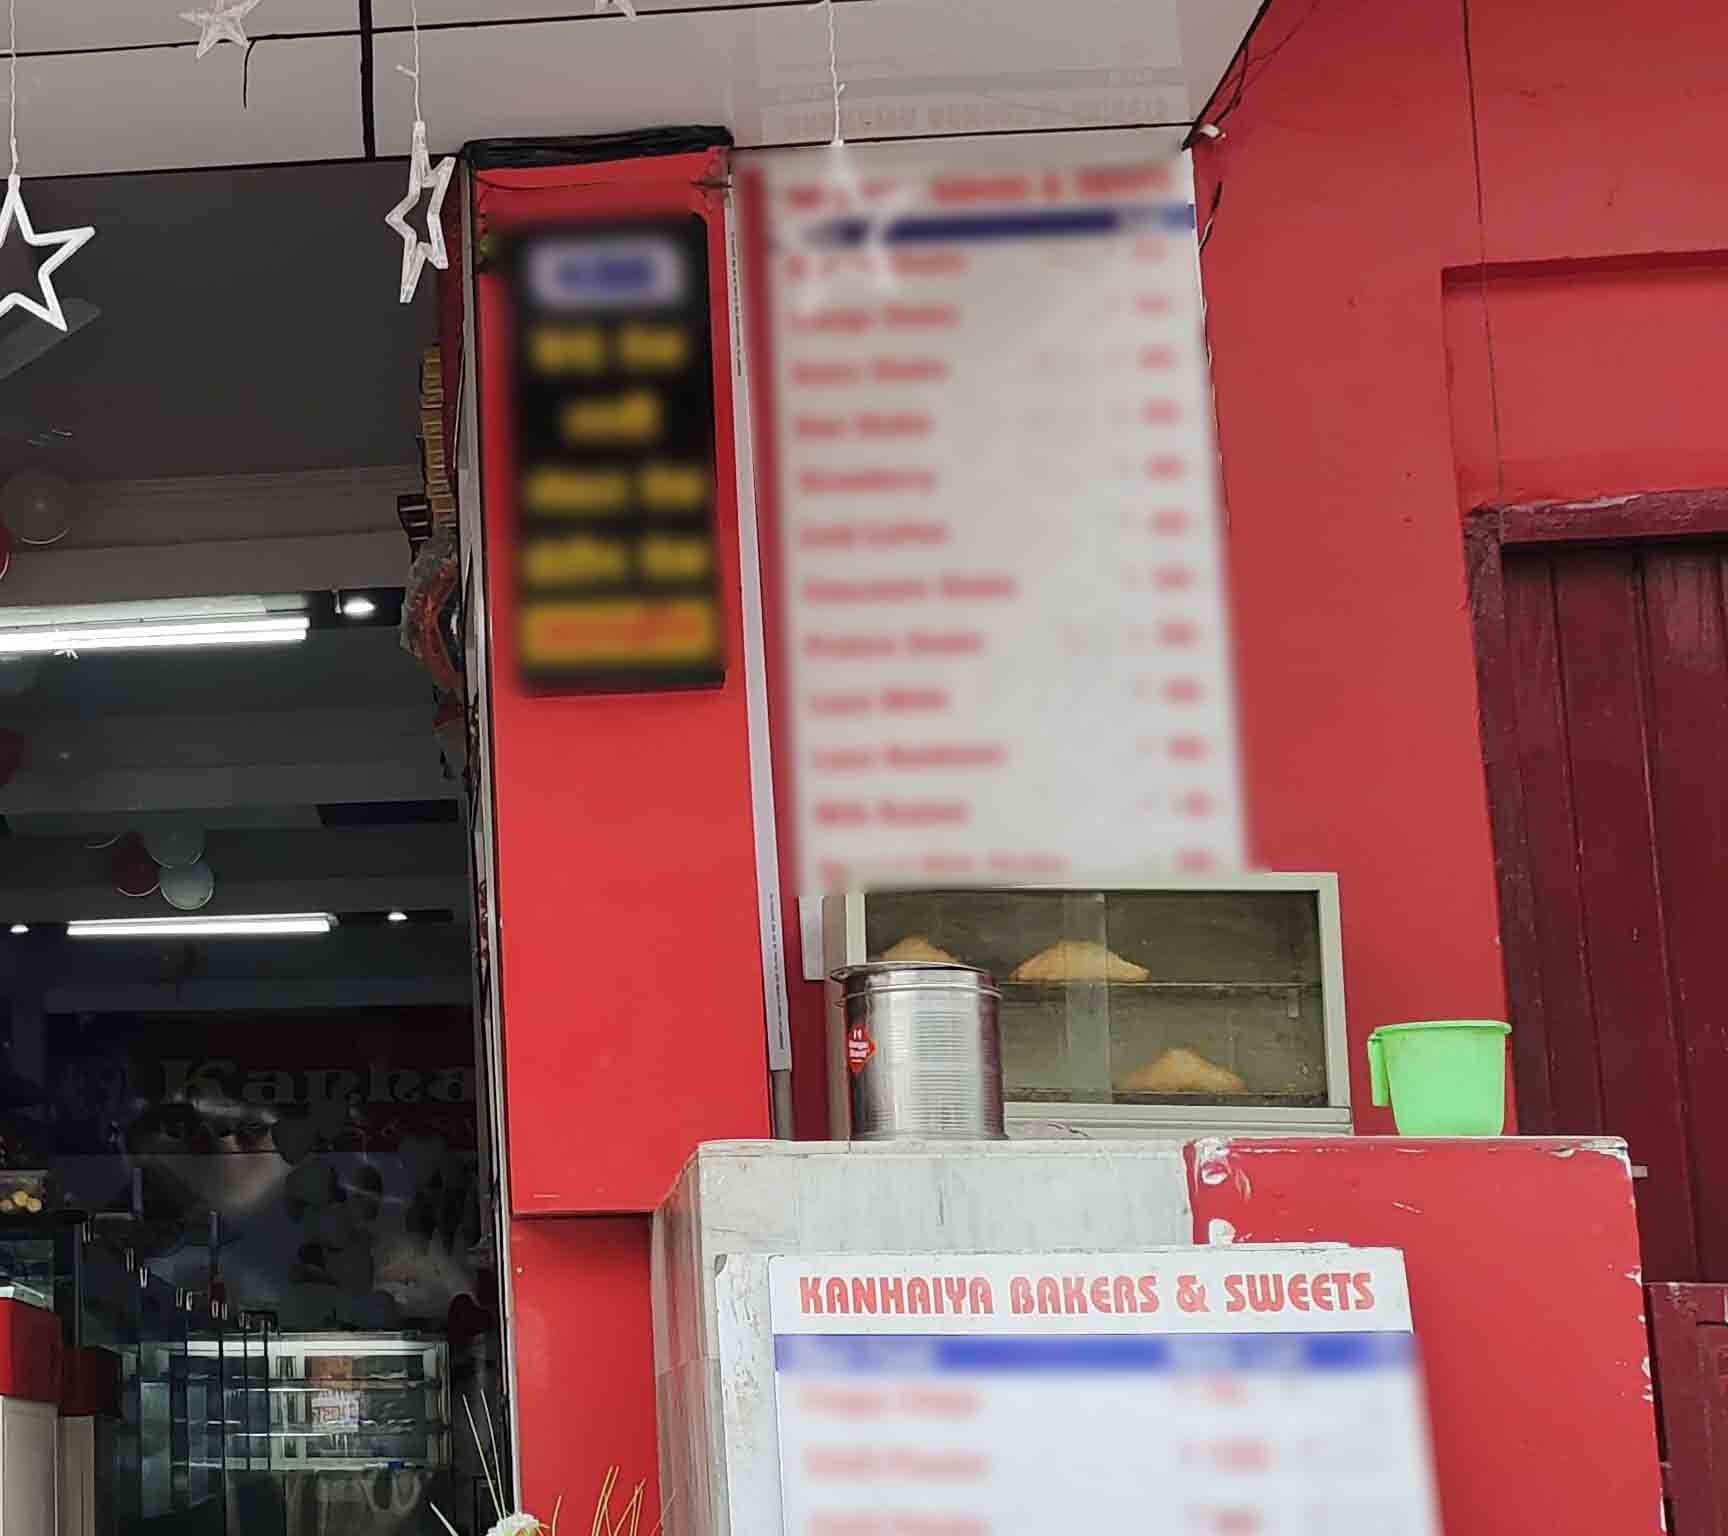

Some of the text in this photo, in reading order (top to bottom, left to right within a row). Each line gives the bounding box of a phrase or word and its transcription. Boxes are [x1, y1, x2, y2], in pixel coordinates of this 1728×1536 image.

[799, 1272, 1375, 1315] KANHAIYA BAKERS & SWEETS
